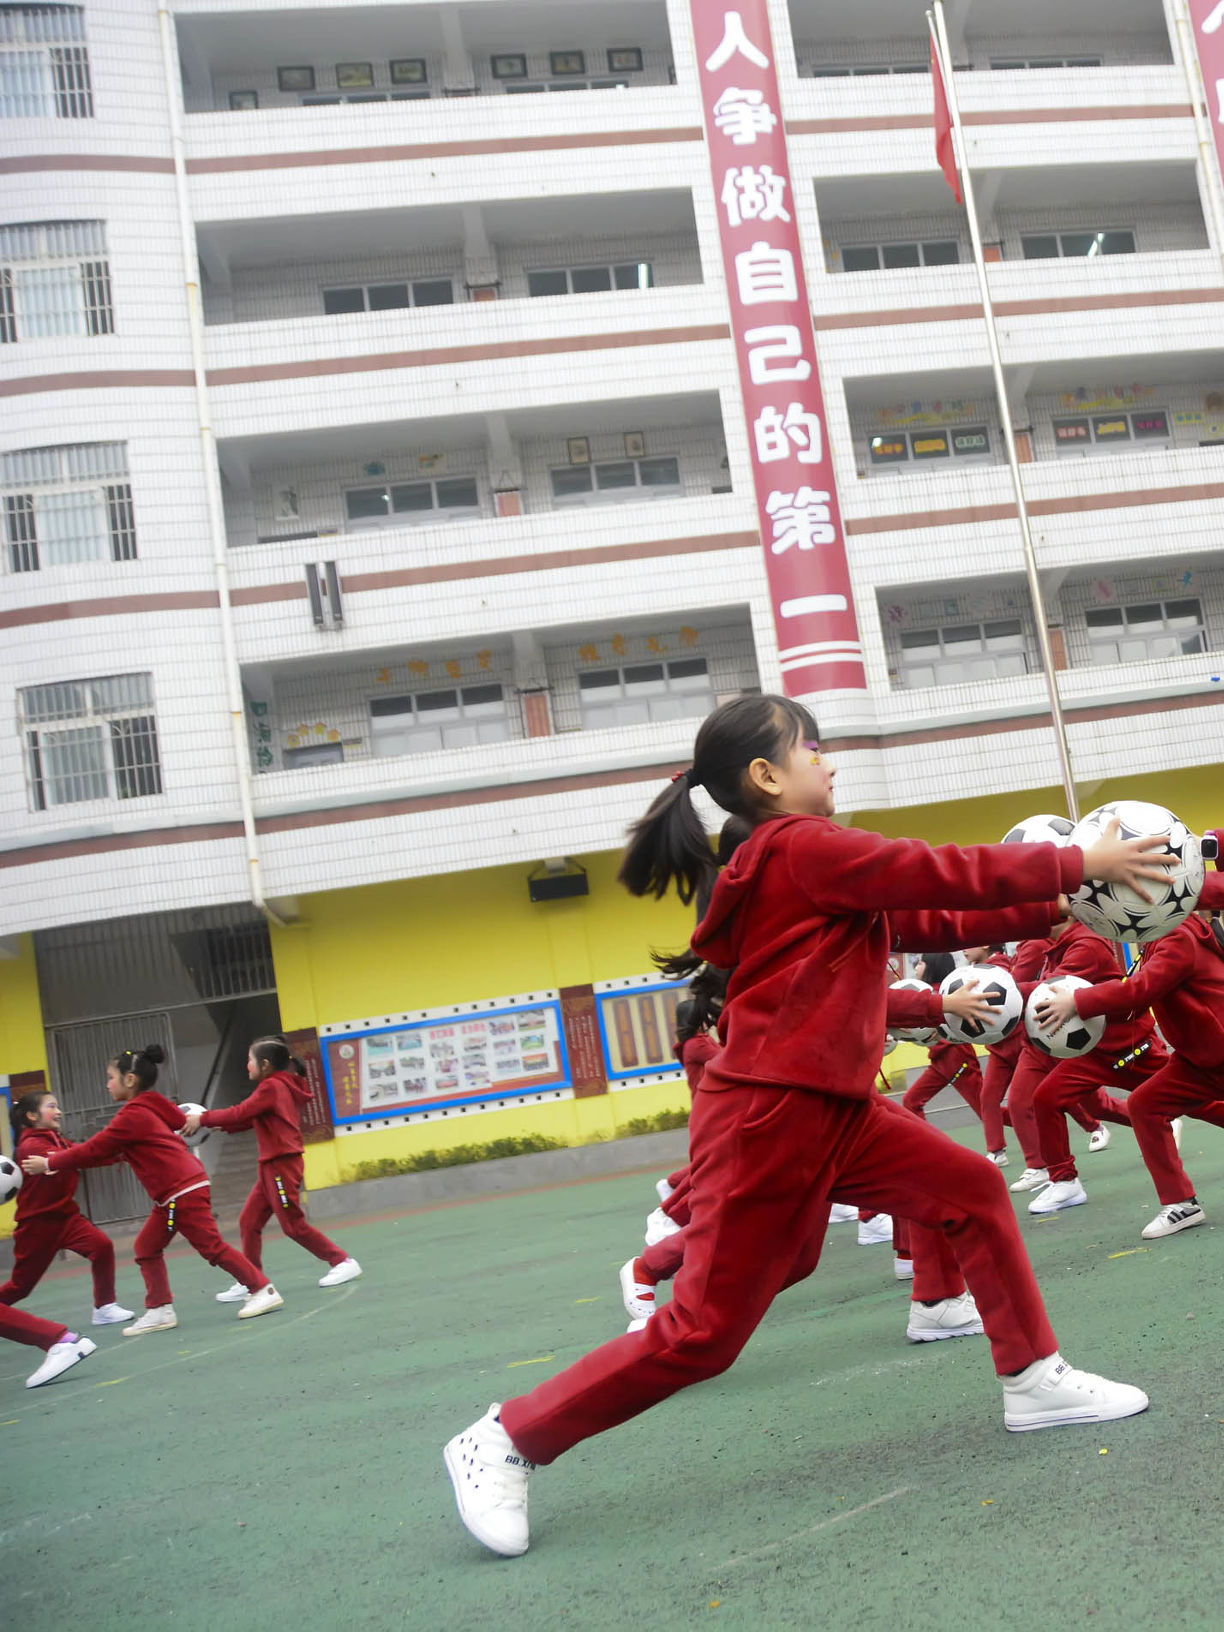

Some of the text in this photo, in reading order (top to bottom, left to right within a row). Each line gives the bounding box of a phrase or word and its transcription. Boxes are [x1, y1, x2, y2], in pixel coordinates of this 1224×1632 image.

[705, 11, 848, 618] 人争做自己的第一
